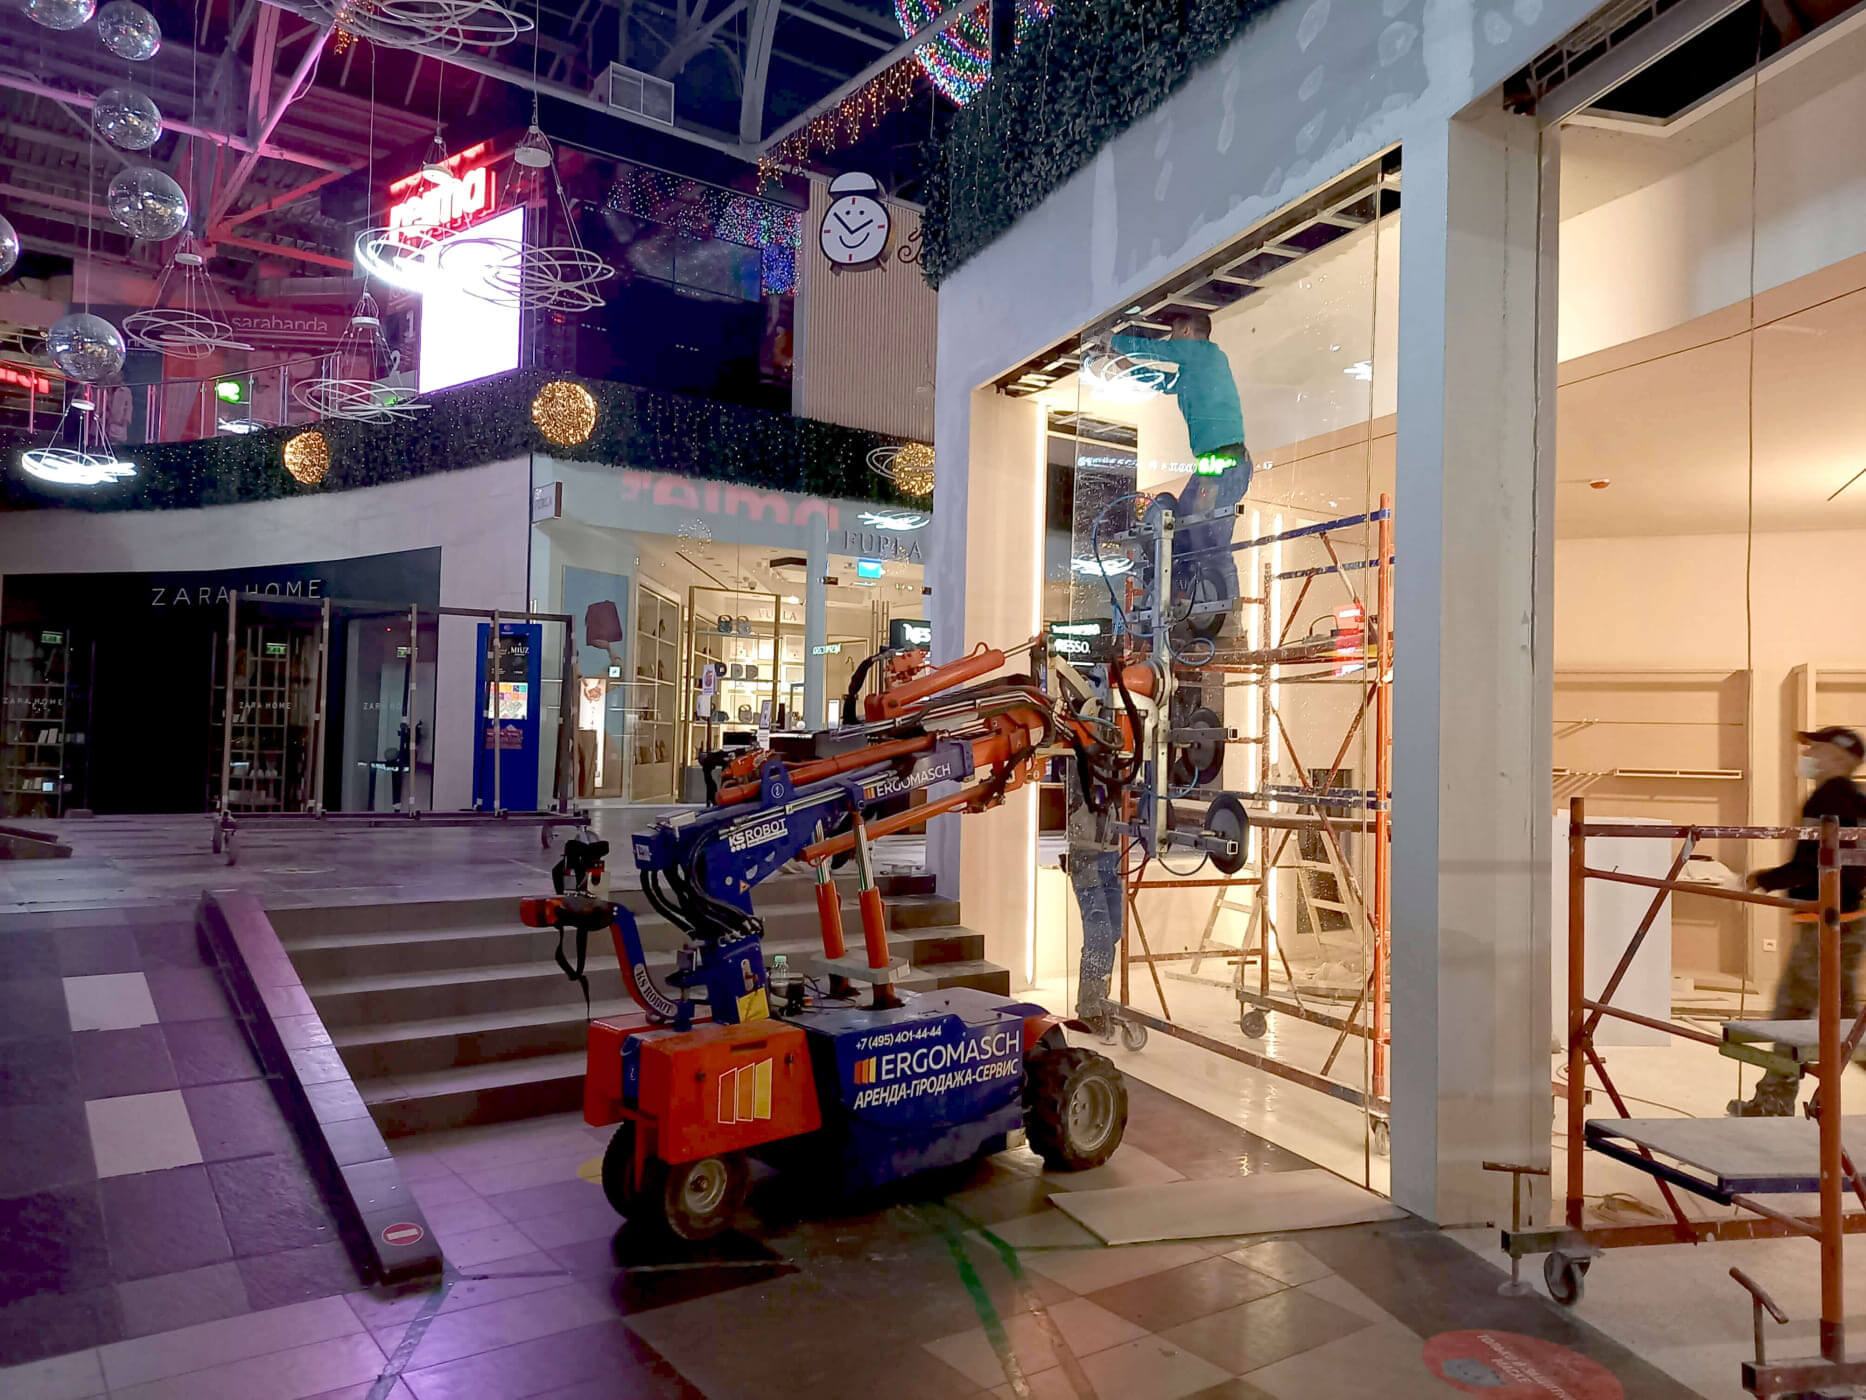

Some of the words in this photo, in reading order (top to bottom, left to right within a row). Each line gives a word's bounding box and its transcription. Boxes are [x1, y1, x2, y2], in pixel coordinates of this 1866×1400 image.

[151, 586, 231, 606] ZARA
[245, 579, 322, 600] HOME
[758, 607, 797, 622] FULA
[876, 763, 951, 799] ERGOMASCH
[855, 1037, 867, 1051] +7
[868, 1033, 894, 1050] (495)
[895, 1025, 943, 1043] 401-44-44
[881, 1030, 1020, 1081] ERGOMASCH
[853, 1058, 1019, 1111] АРЕНДА-ПРОДАЖА-СЕРВИС
